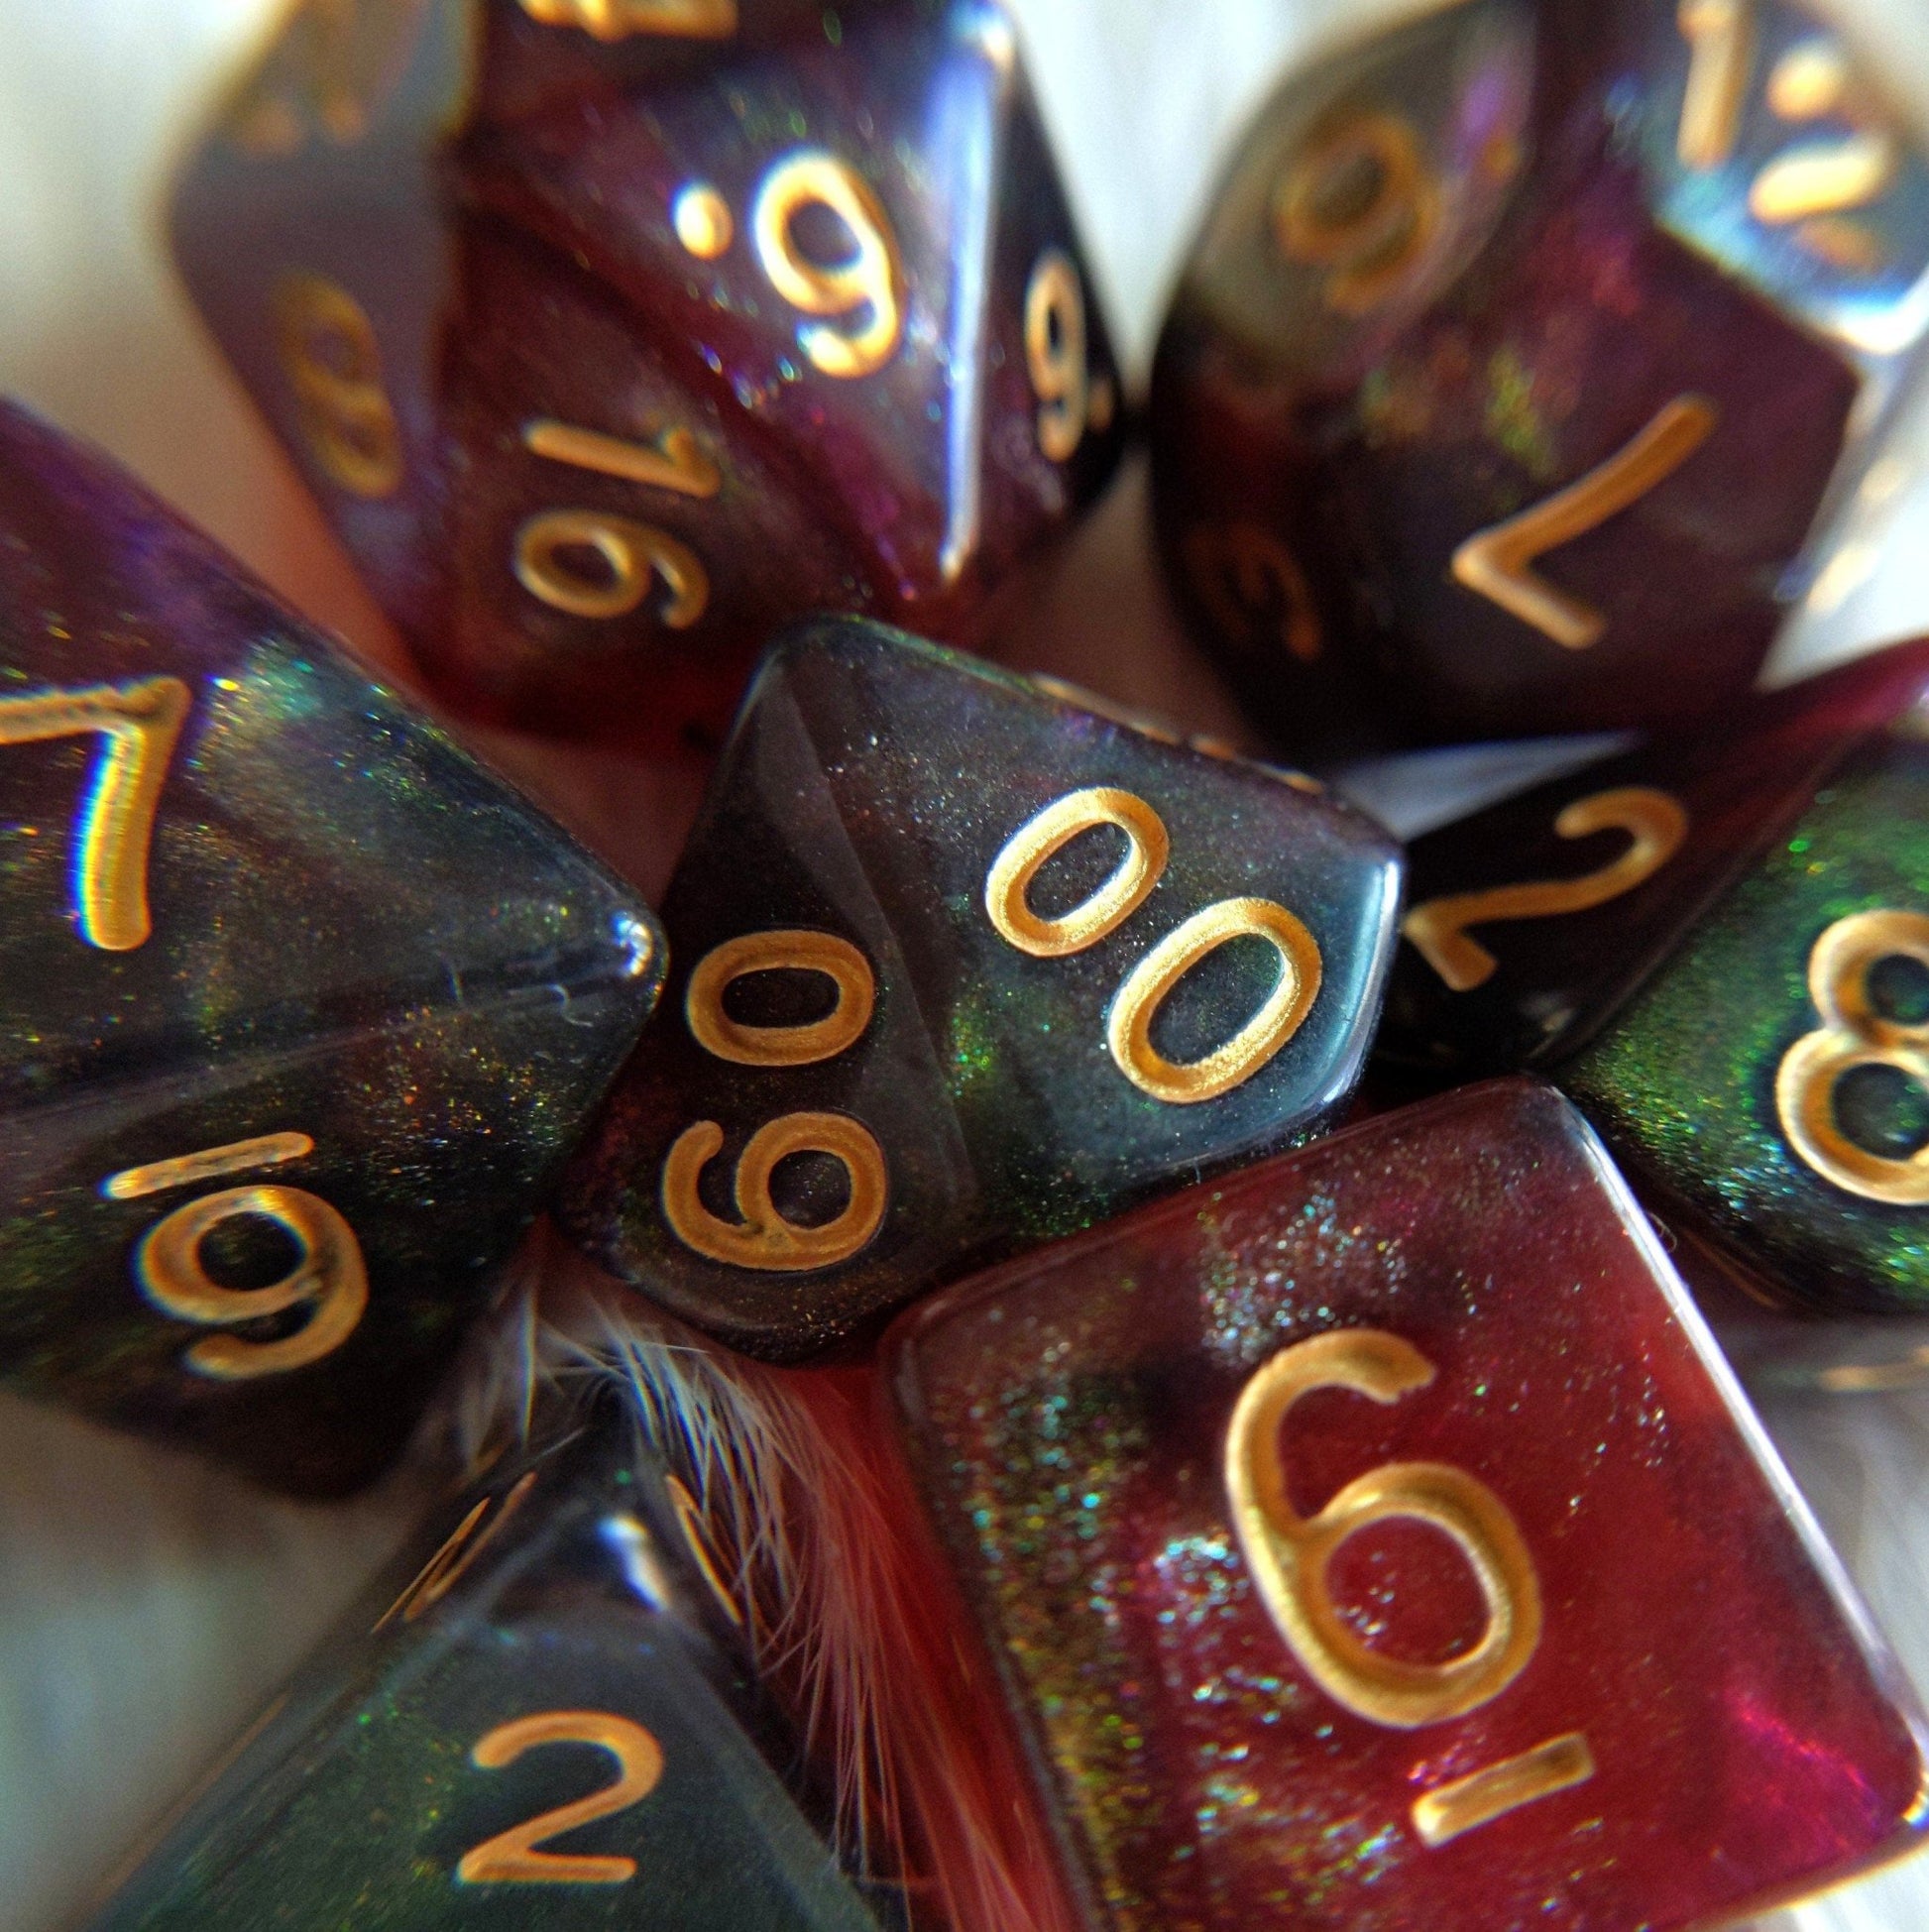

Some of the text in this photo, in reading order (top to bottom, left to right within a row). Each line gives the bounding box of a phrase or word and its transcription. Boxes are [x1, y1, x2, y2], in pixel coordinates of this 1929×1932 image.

[513, 418, 724, 630] 16
[1450, 394, 1719, 649] 7
[0, 675, 191, 951] 7
[1404, 787, 1688, 990] 2
[985, 787, 1322, 1103] 00
[1774, 908, 1929, 1204] 8
[456, 1709, 665, 1885] 2
